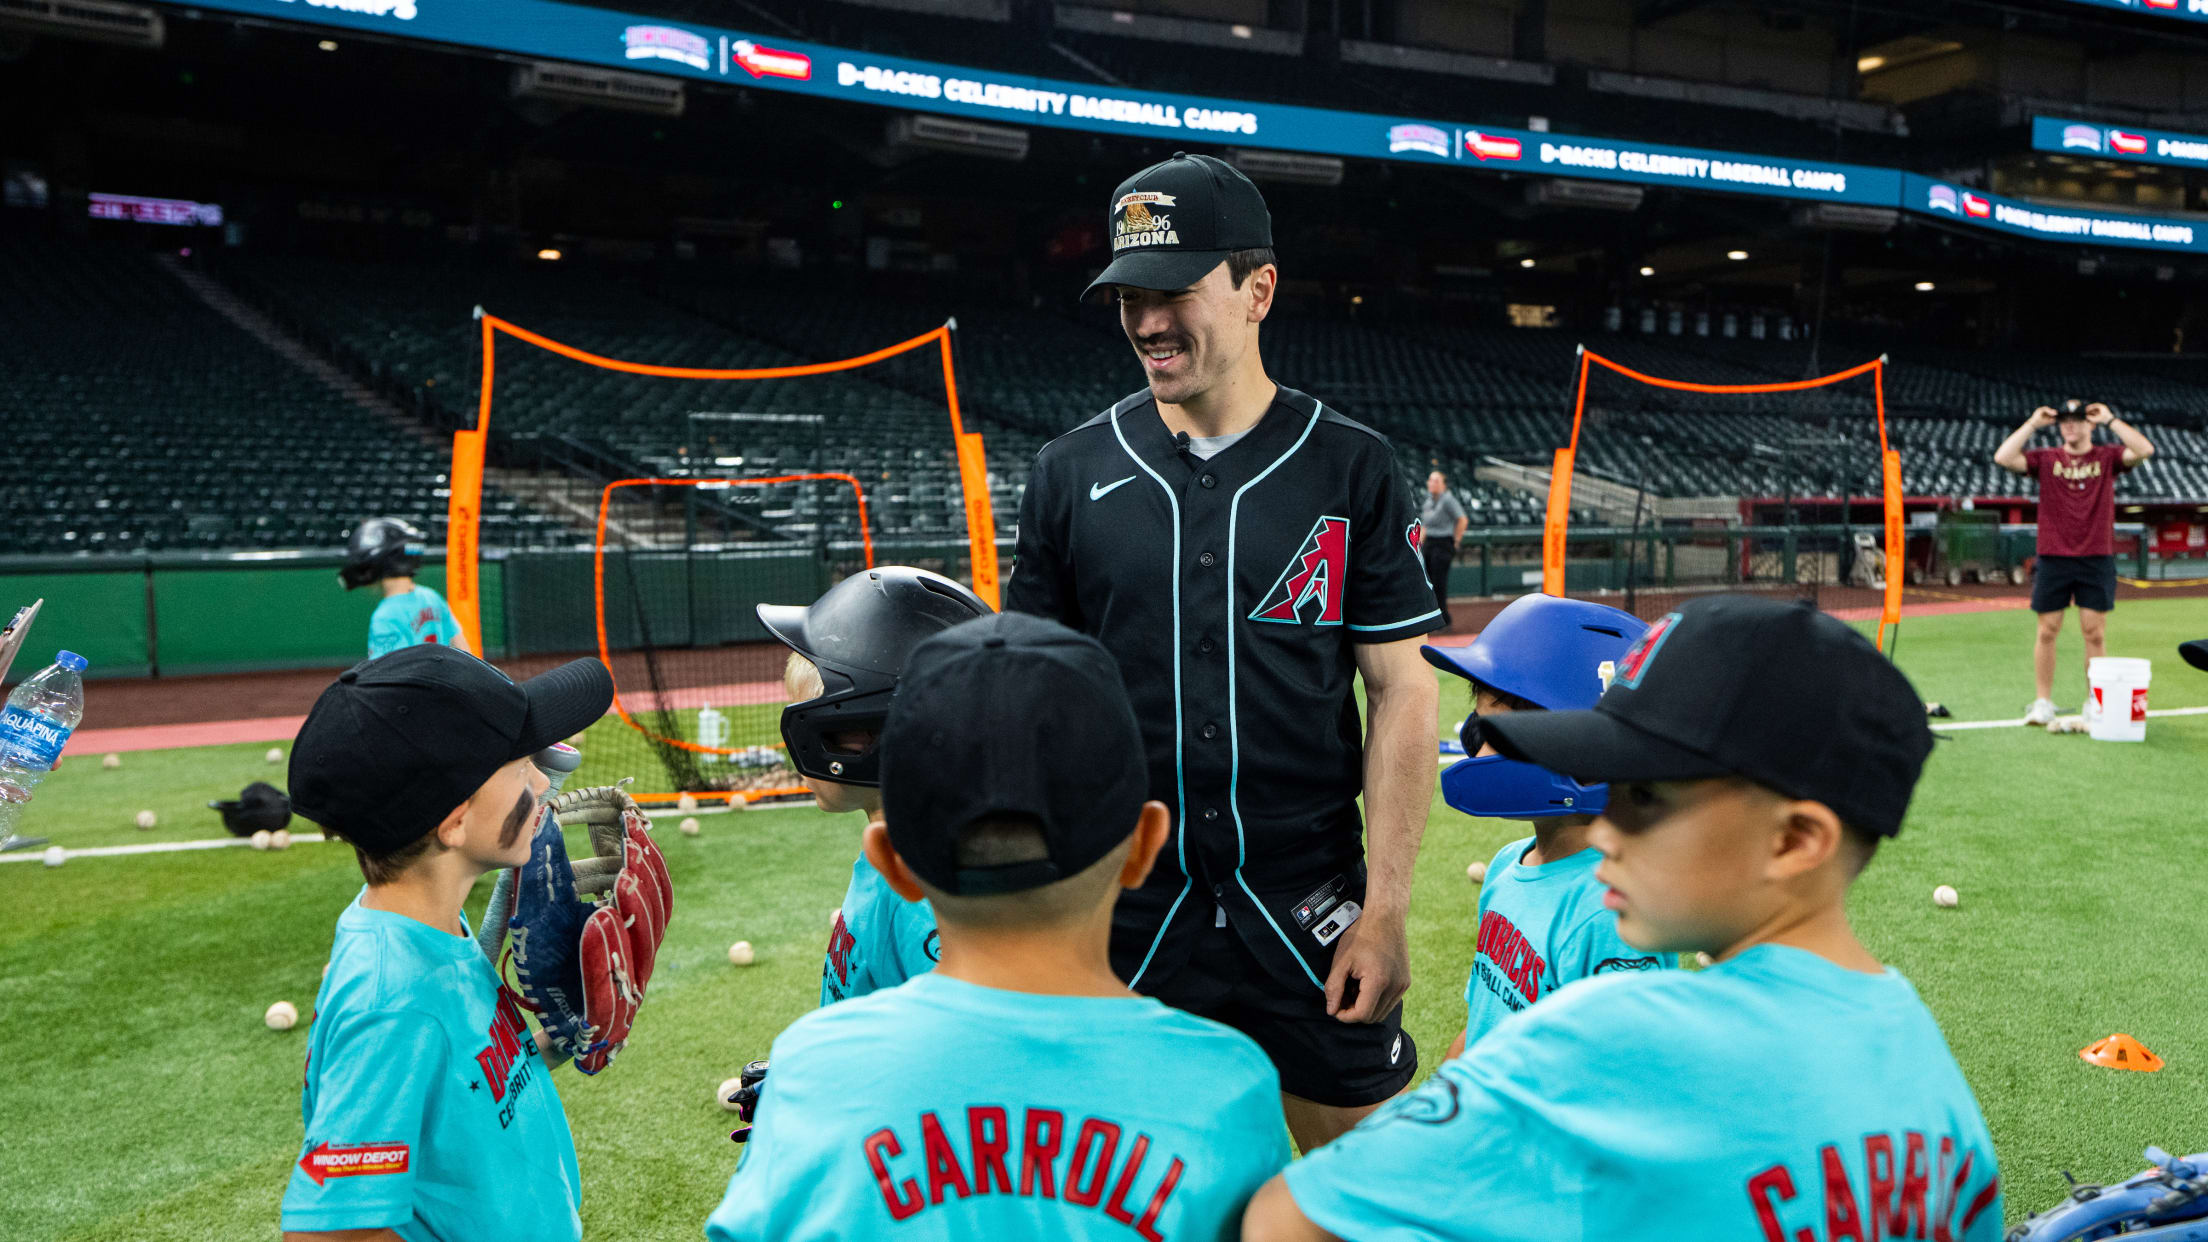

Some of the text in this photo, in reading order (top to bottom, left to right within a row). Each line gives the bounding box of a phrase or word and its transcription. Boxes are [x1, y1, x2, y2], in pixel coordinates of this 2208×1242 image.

[838, 62, 942, 99] D-BACKS
[943, 78, 1067, 115] CELEBRITY
[1069, 94, 1182, 128] BASEBALL
[1183, 107, 1258, 135] CAMPS
[1540, 143, 1617, 169] D-BACKS
[1618, 151, 1710, 178] CELEBRITY
[1710, 160, 1792, 187] BASEBALL
[1792, 169, 1846, 193] CAMPS
[1152, 214, 1171, 231] 96
[1113, 230, 1180, 252] ARIZONA
[3, 713, 59, 747] AQUAFINA
[313, 1150, 408, 1166] WINDOW DEPOT
[864, 1105, 1185, 1242] CARROLL
